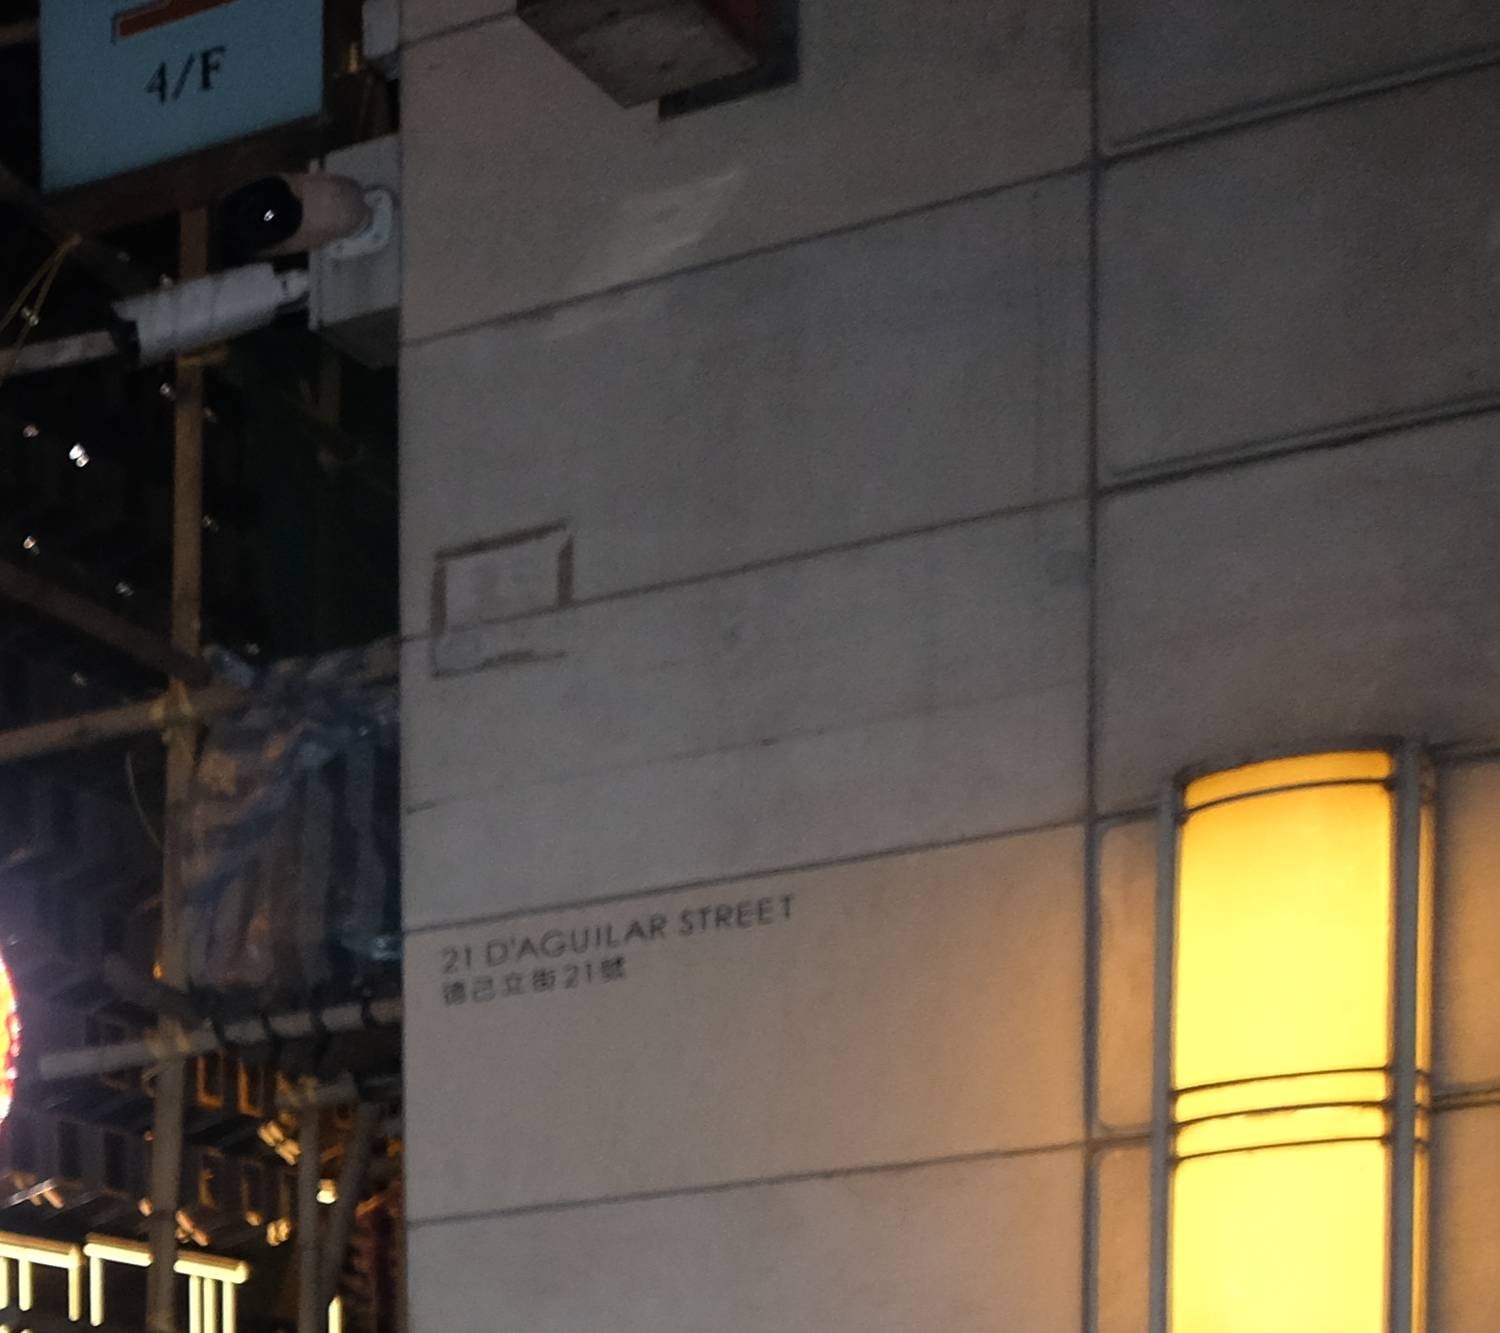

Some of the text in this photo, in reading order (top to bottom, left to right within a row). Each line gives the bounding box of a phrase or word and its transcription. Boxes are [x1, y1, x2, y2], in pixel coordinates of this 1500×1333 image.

[144, 44, 227, 105] 4/F
[439, 891, 796, 975] 21 D'AGUILAR STREET
